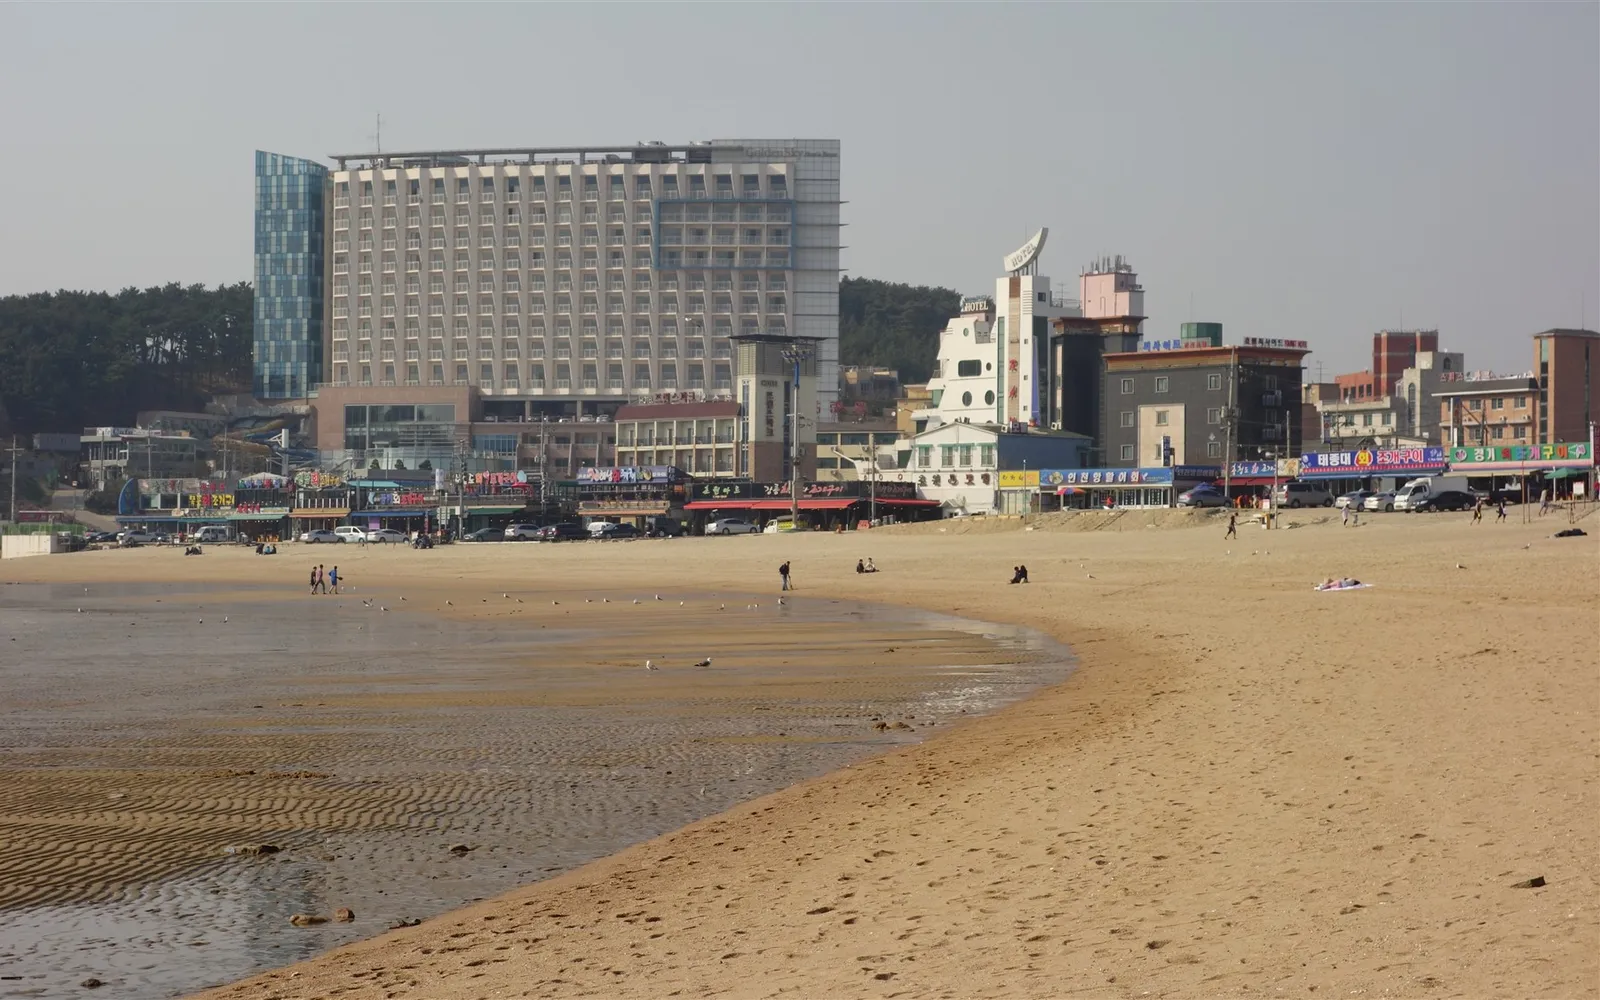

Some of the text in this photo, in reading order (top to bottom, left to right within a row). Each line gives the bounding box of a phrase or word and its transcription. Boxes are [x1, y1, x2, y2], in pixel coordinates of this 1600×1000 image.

[1012, 243, 1037, 268] HOTEL
[964, 301, 989, 312] HOTEL
[1317, 452, 1350, 467] 태종대
[1376, 448, 1424, 465] 조개구이
[1474, 447, 1500, 462] 경기
